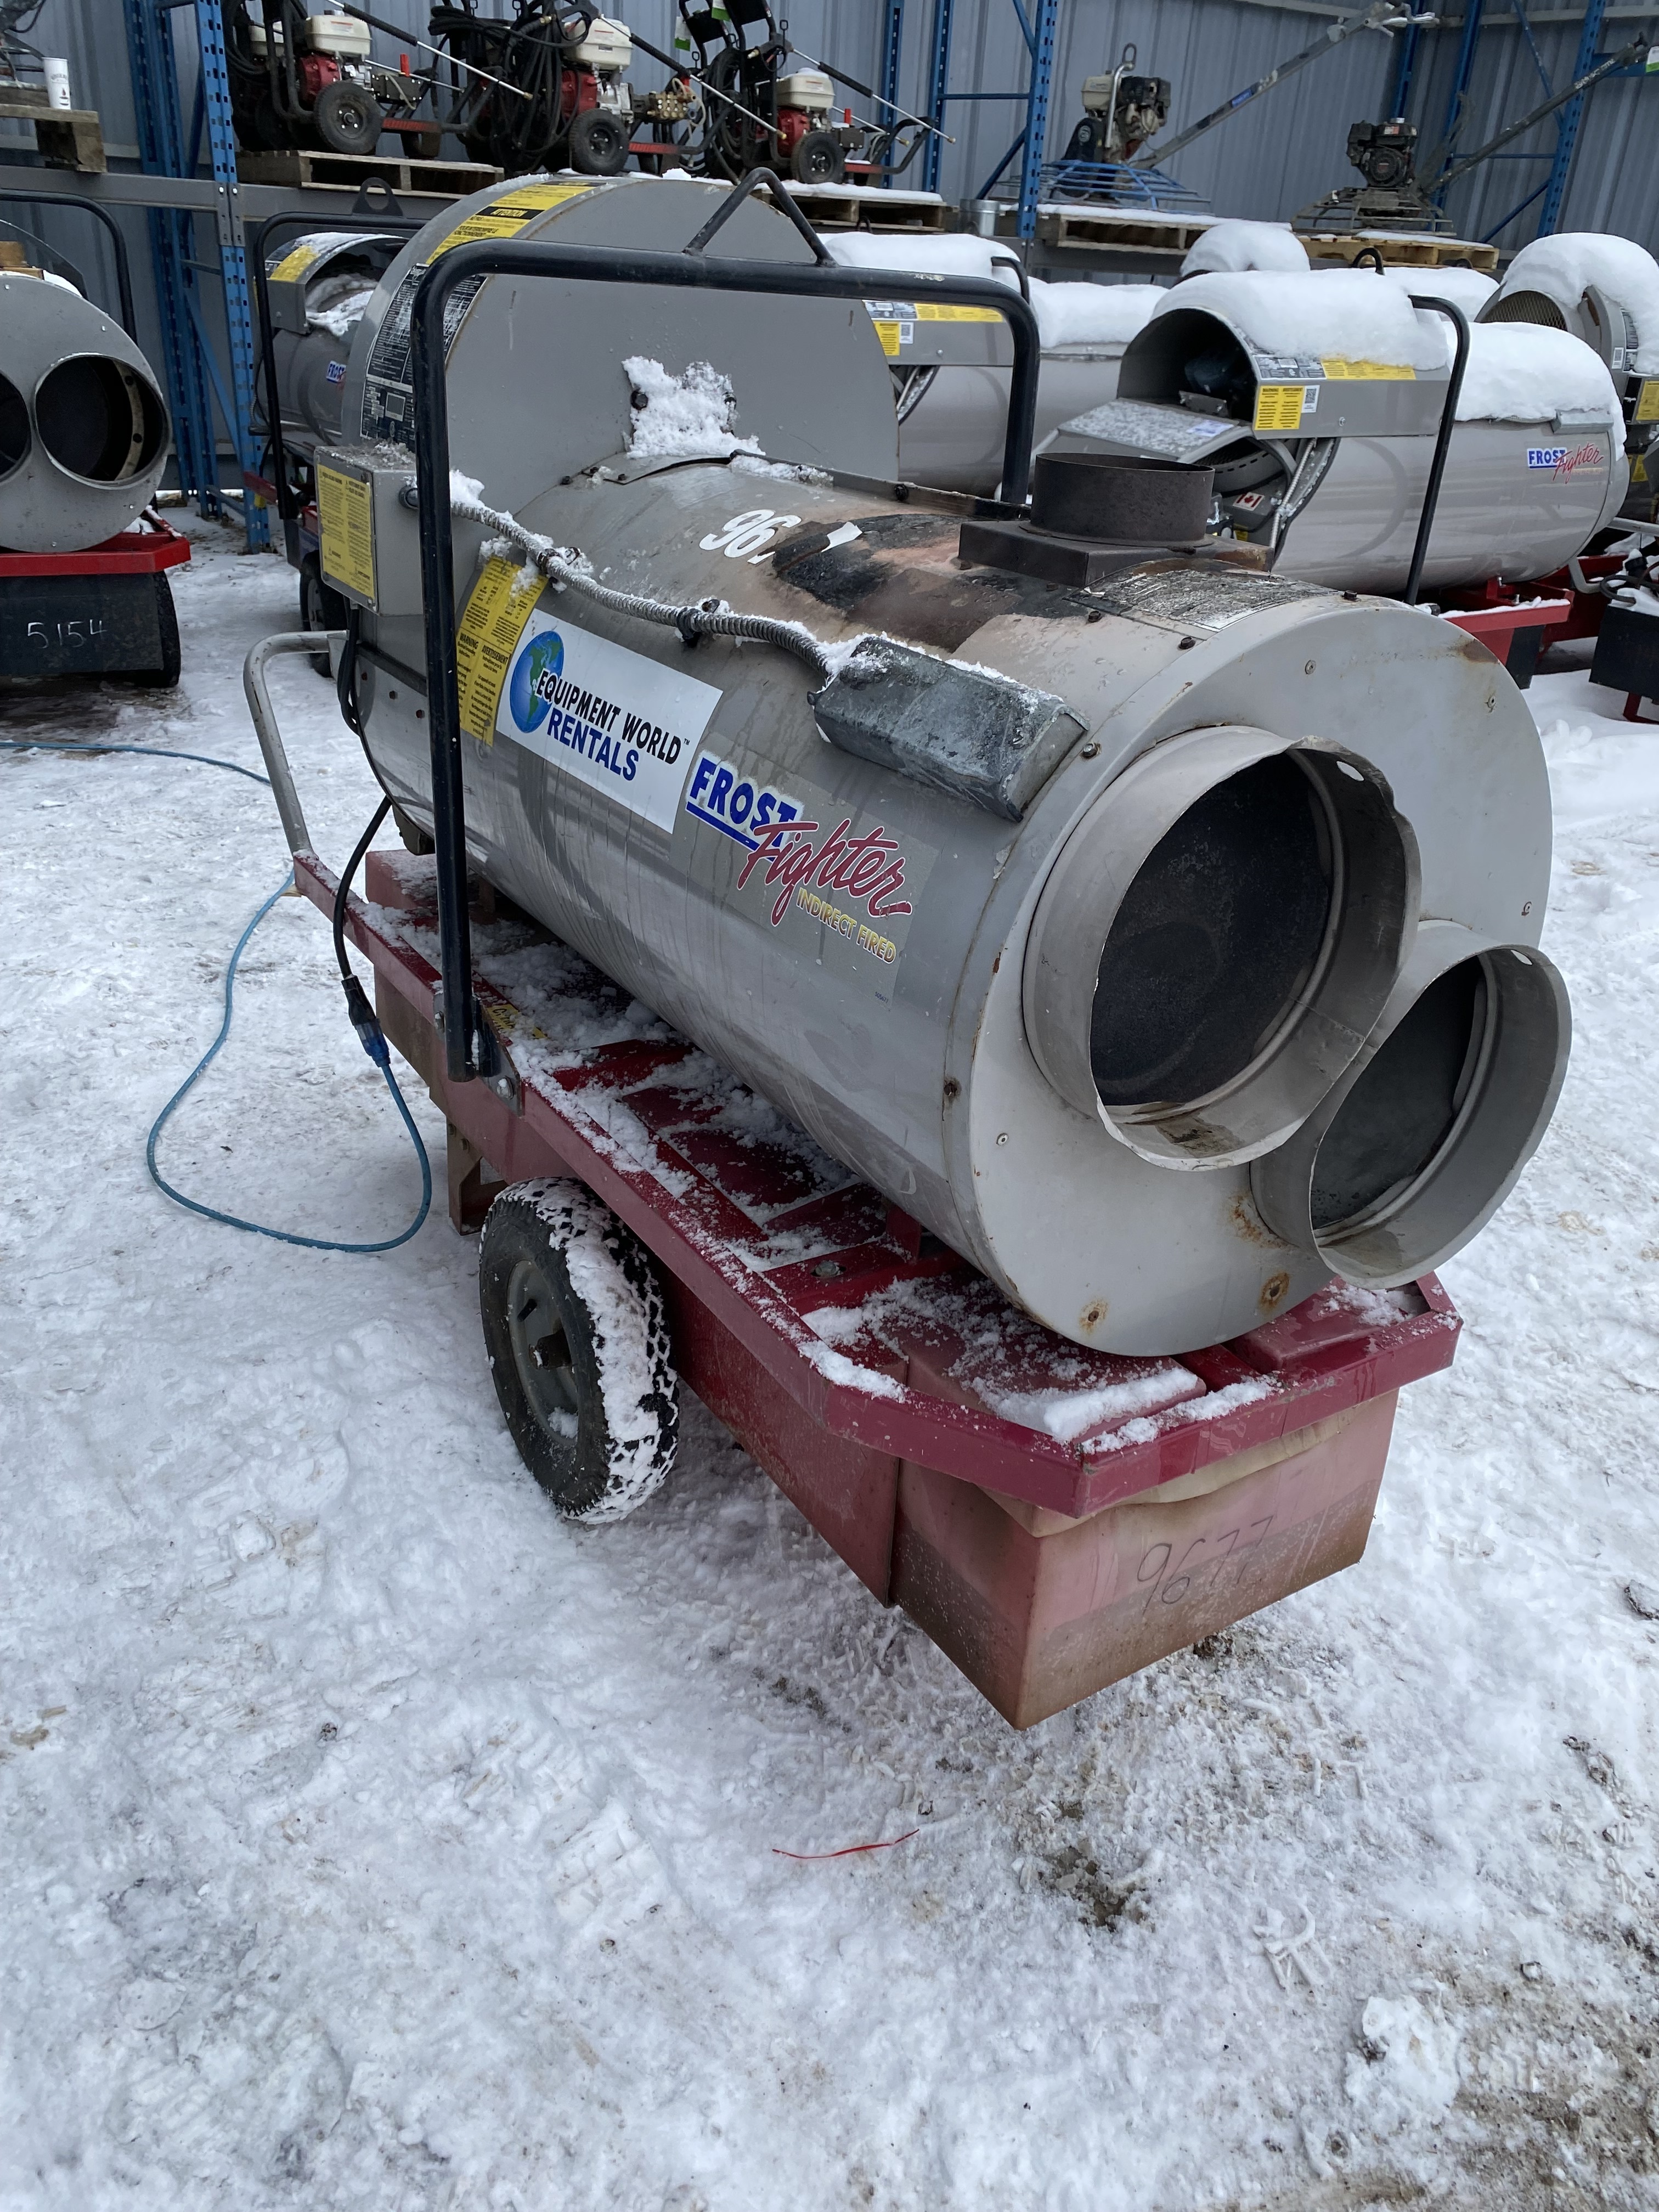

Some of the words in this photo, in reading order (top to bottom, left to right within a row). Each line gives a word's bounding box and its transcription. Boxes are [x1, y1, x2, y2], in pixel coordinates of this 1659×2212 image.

[1528, 450, 1566, 465] FROST
[1552, 442, 1604, 484] Fighter
[27, 619, 108, 650] 5154
[537, 669, 621, 733] EQUIPMENT
[546, 707, 639, 781] RENTALS
[689, 757, 798, 848] FROST
[737, 818, 913, 927] Fighter
[797, 887, 857, 939] INDIRECT
[856, 923, 896, 964] FIRED
[1137, 1515, 1274, 1615] 9677
